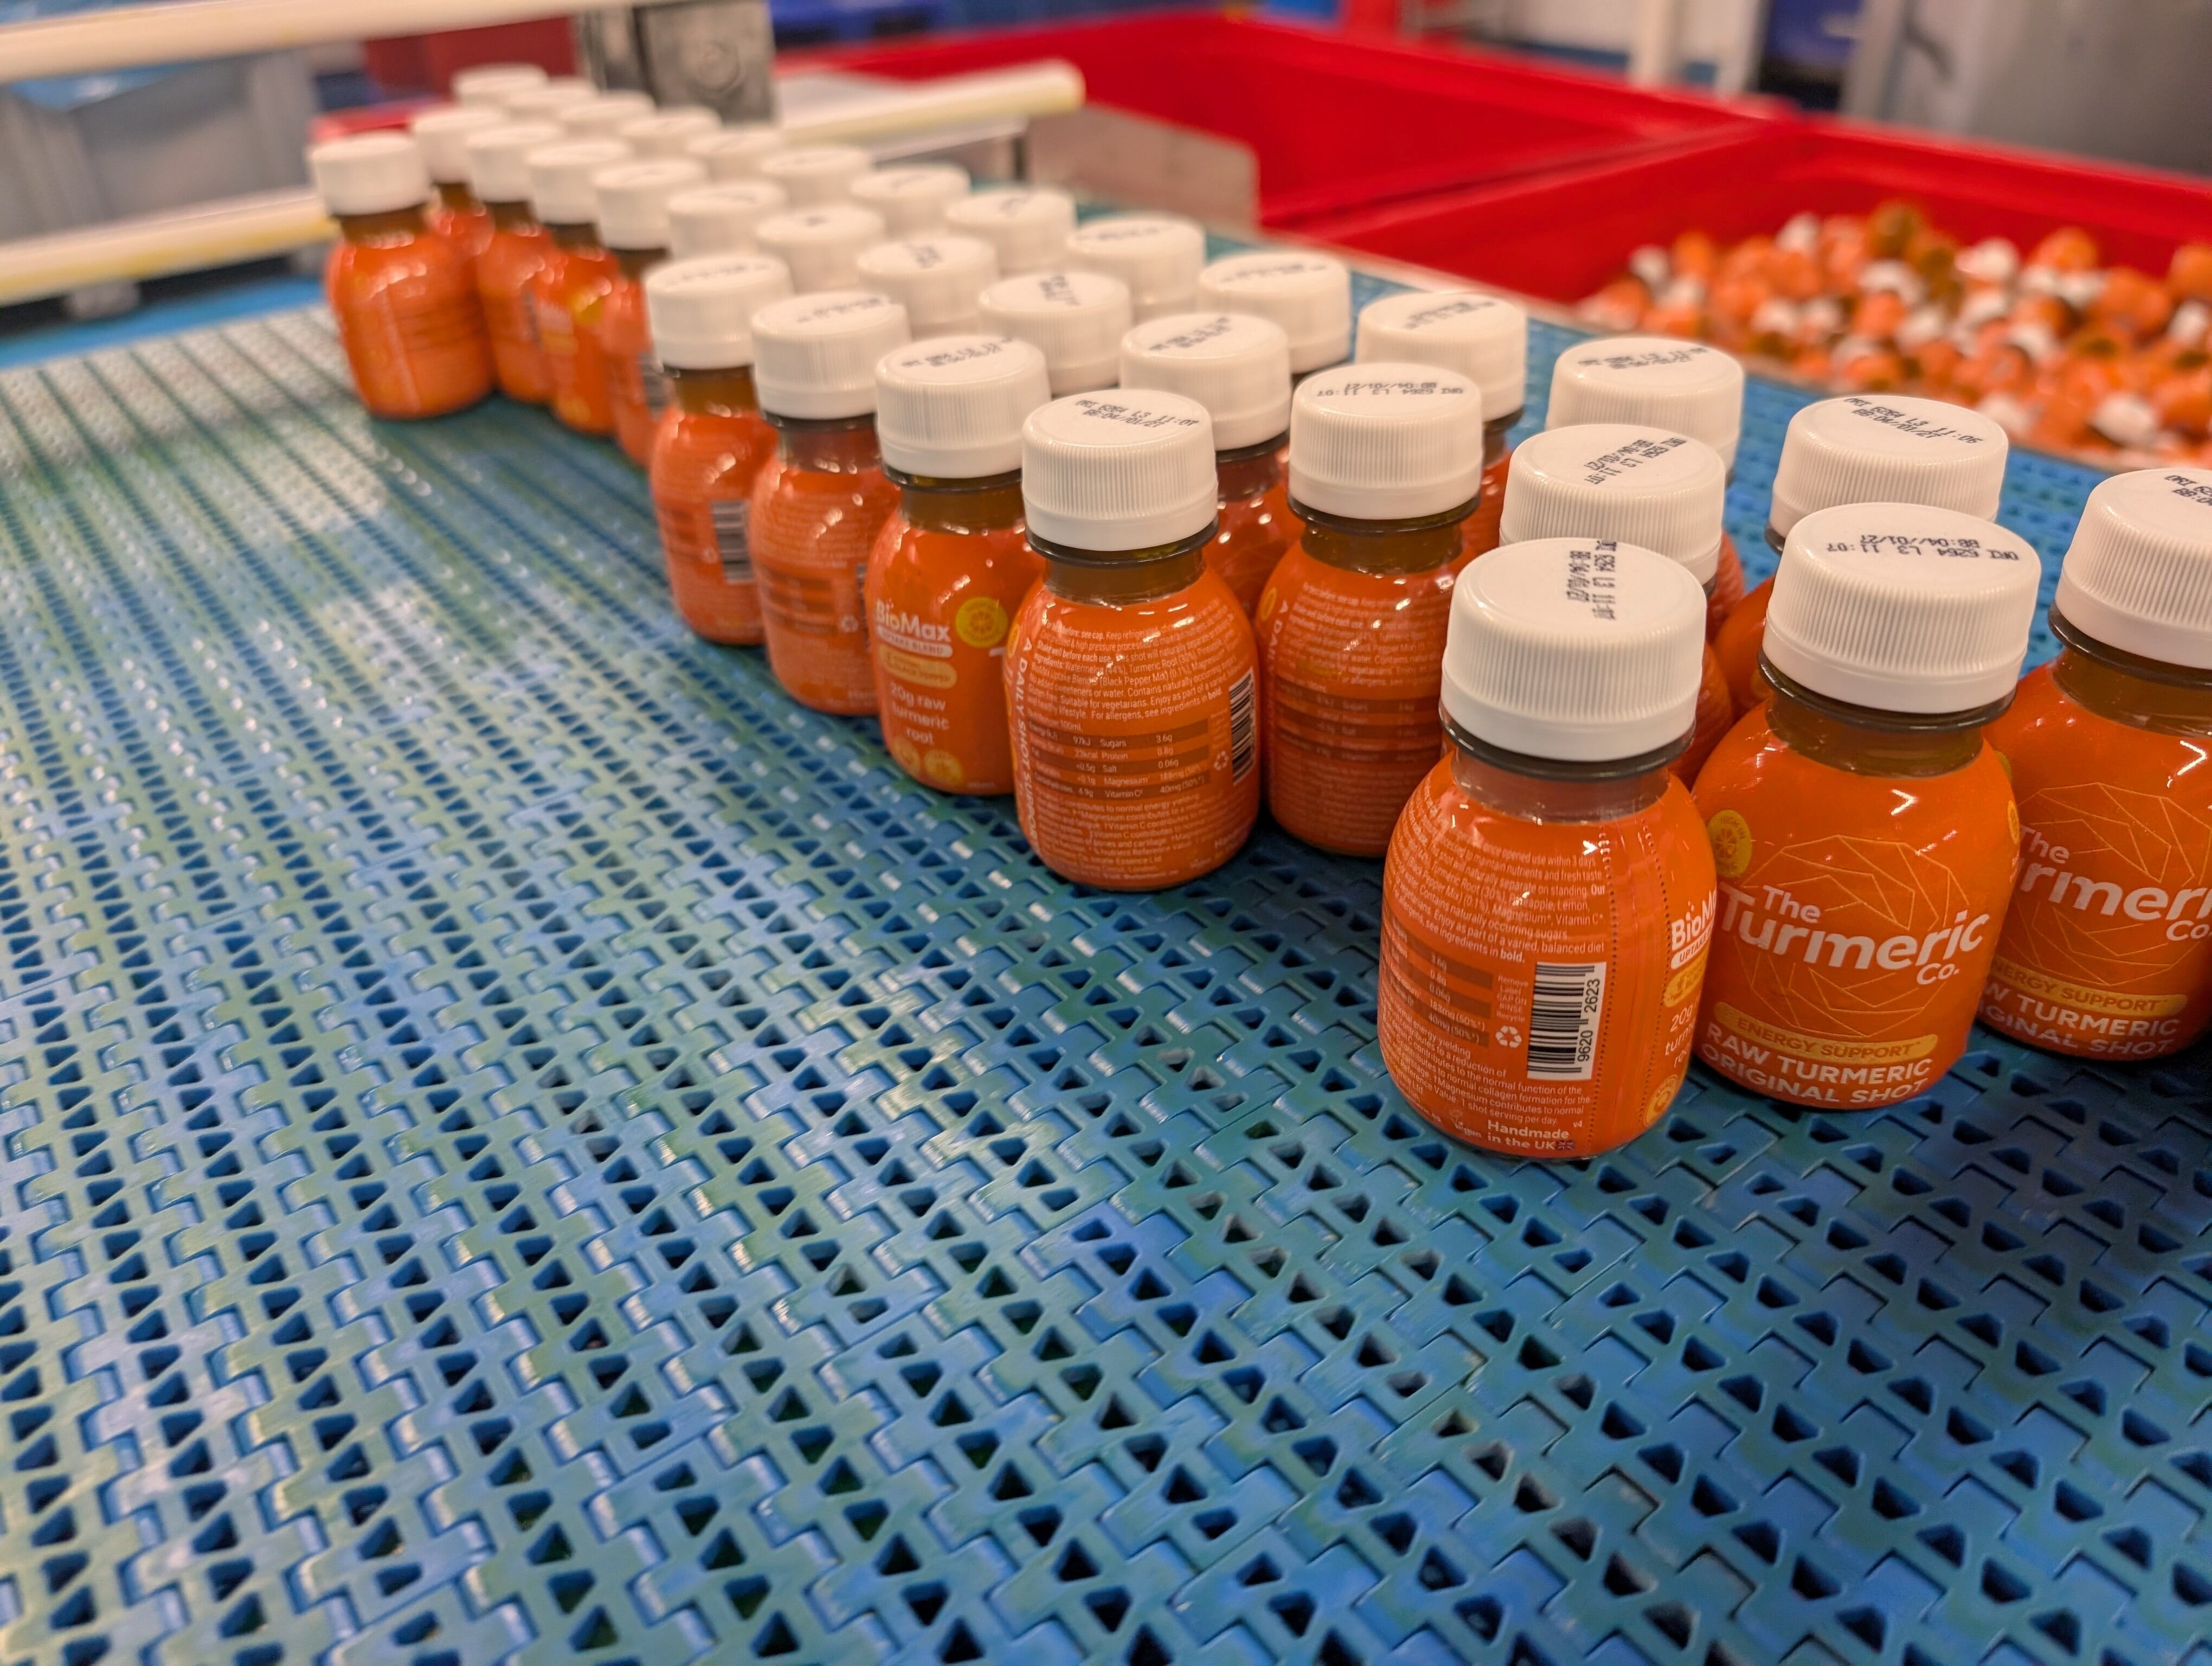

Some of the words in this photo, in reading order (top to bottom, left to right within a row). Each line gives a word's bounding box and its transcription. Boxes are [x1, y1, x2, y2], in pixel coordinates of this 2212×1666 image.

[1156, 415, 1200, 426] 11:07
[1843, 398, 1872, 407] ORI
[1870, 407, 1905, 418] 6264
[1906, 418, 1928, 426] L3
[1932, 427, 1984, 444] 11:06
[1619, 458, 1643, 468] L3
[2164, 475, 2197, 486] ORI
[1827, 542, 1881, 554] 11:07
[1897, 544, 1921, 555] L3
[1937, 548, 1980, 558] 6264
[1986, 549, 2020, 560] ORI
[874, 599, 951, 642] BioMax
[1076, 639, 1088, 651] high
[1089, 643, 1116, 652] pressure
[1081, 631, 1092, 639] see
[1107, 632, 1122, 641] Keep
[1063, 649, 1081, 660] before
[1083, 652, 1098, 662] each
[1131, 652, 1146, 662] shot
[1129, 663, 1161, 673] Turmeric
[1161, 657, 1177, 668] Root
[1055, 683, 1093, 697] sweeteners
[1128, 687, 1161, 697] Contains
[1163, 676, 1193, 691] naturally
[1124, 675, 1151, 687] Pepper
[1152, 671, 1169, 683] Mix)
[917, 695, 946, 712] raw
[1060, 695, 1089, 707] Suitable
[1090, 699, 1100, 708] for
[1150, 693, 1171, 707] Enjoy
[1172, 693, 1181, 701] as
[1182, 688, 1197, 702] part
[892, 701, 950, 730] turmeric
[1091, 710, 1104, 720] For
[1106, 709, 1144, 722] allergens,
[1145, 708, 1159, 718] see
[1160, 697, 1201, 715] ingredients
[906, 727, 934, 745] root
[1100, 738, 1127, 749] Sugars
[1156, 734, 1173, 744] 3.6g
[1101, 750, 1128, 760] Protein
[1157, 747, 1174, 756] 0.8g
[1102, 764, 1117, 773] Salt
[1158, 759, 1179, 769] 0.06g
[1105, 790, 1134, 799] Vitamin
[1160, 783, 1182, 793] 40mg
[2020, 824, 2070, 864] The
[1502, 848, 1532, 863] opened
[1532, 855, 1546, 864] use
[1547, 855, 1571, 866] within
[1507, 864, 1542, 880] nutrients
[1545, 870, 1559, 881] and
[1561, 869, 1581, 881] fresh
[1461, 877, 1480, 894] Root
[1557, 900, 1590, 912] Lemon,
[1500, 877, 1536, 894] separate
[1538, 884, 1549, 894] on
[1591, 883, 1605, 895] Our
[2018, 857, 2212, 920] rmer
[1419, 885, 1450, 912] Contains
[1451, 905, 1487, 929] naturally
[1488, 918, 1534, 940] occurring
[1762, 884, 1821, 925] The
[1555, 914, 1590, 926] Vitamin
[1719, 883, 1990, 970] Turmeric
[1434, 908, 1455, 930] Enjoy
[1467, 927, 1486, 941] part
[1508, 938, 1539, 952] varied,
[1541, 941, 1586, 954] balanced
[1587, 943, 1605, 953] diet
[1439, 927, 1488, 955] ingredients
[1500, 947, 1526, 964] bold.
[1497, 974, 1529, 988] Remove
[1915, 962, 1960, 985] Co.
[1993, 960, 2058, 994] NERGY
[1429, 982, 1451, 1004] 0.06g
[1583, 978, 1600, 1014] 2623
[1429, 999, 1456, 1022] 188mg
[1670, 1003, 1694, 1033] 20g
[2016, 994, 2181, 1037] TURMERIC
[1428, 1013, 1450, 1034] 40mg
[1978, 998, 2078, 1049] IGINAL
[2088, 1038, 2175, 1055] SHOT
[1413, 1020, 1437, 1042] energy
[1438, 1037, 1471, 1061] yielding
[1577, 1029, 1593, 1062] 9620
[1737, 1017, 1818, 1053] ENERGY
[1707, 1023, 1771, 1065] RAW
[1777, 1055, 1934, 1085] TURMERIC
[1413, 1041, 1456, 1073] contributes
[1467, 1070, 1482, 1082] the
[1483, 1076, 1516, 1090] normal
[1518, 1081, 1556, 1094] function
[1557, 1086, 1568, 1094] of
[1568, 1086, 1583, 1094] the
[1452, 1054, 1495, 1075] reduction
[1496, 1069, 1507, 1078] of
[1701, 1043, 1840, 1103] ORIGINAL
[1849, 1078, 1928, 1103] SHOT
[1446, 1073, 1477, 1091] normal
[1478, 1085, 1517, 1101] collagen
[1519, 1093, 1565, 1105] formation
[1565, 1096, 1576, 1104] for
[1578, 1095, 1591, 1104] the
[1467, 1101, 1488, 1114] shot
[1489, 1108, 1523, 1123] serving
[1525, 1115, 1540, 1124] per
[1489, 1099, 1542, 1114] contributes
[1544, 1106, 1554, 1115] to
[1553, 1105, 1585, 1115] normal
[1487, 1119, 1570, 1139] Handmade
[1573, 1119, 1583, 1129] v4
[1487, 1132, 1502, 1144] in
[1505, 1136, 1531, 1149] the
[1534, 1140, 1556, 1150] UK
